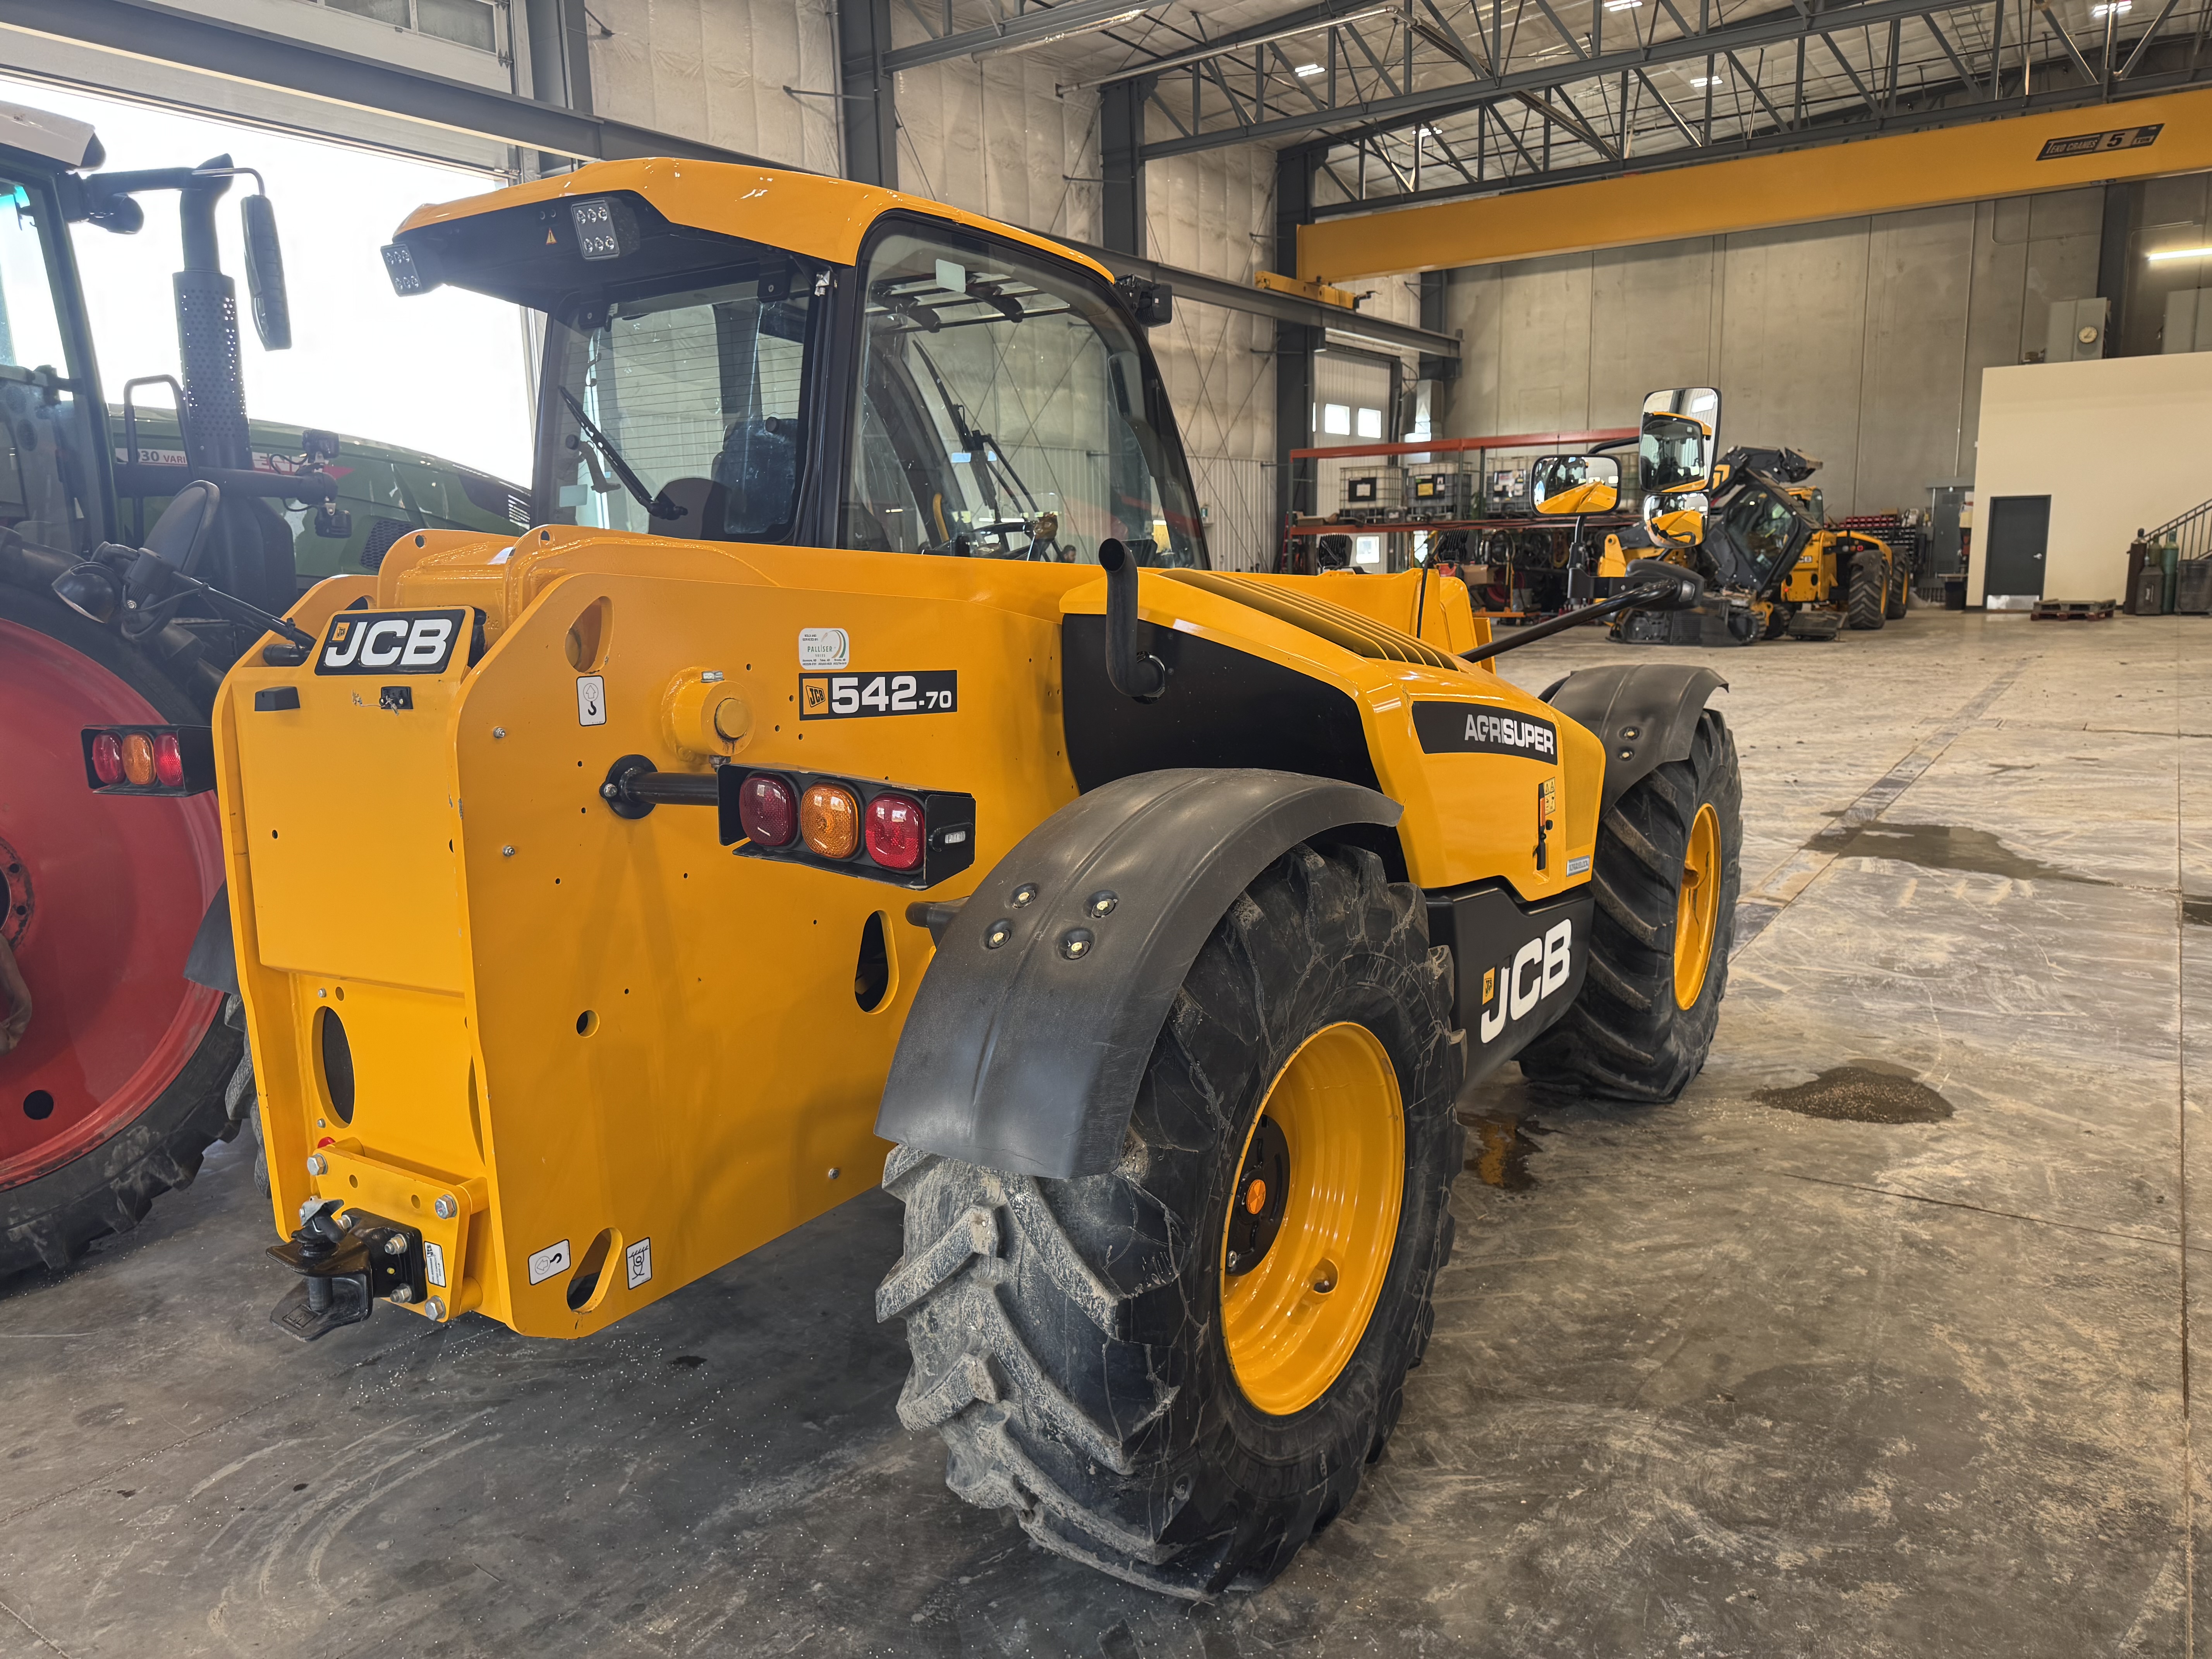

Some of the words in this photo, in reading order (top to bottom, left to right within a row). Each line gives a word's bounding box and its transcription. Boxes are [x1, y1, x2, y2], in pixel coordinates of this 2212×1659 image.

[2107, 132, 2125, 147] 5
[138, 450, 160, 462] 30
[163, 455, 186, 464] VARI
[325, 619, 452, 666] JCB
[809, 688, 825, 705] JCB
[1464, 714, 1554, 755] AGRISUPER
[1481, 919, 1572, 1044] JCB
